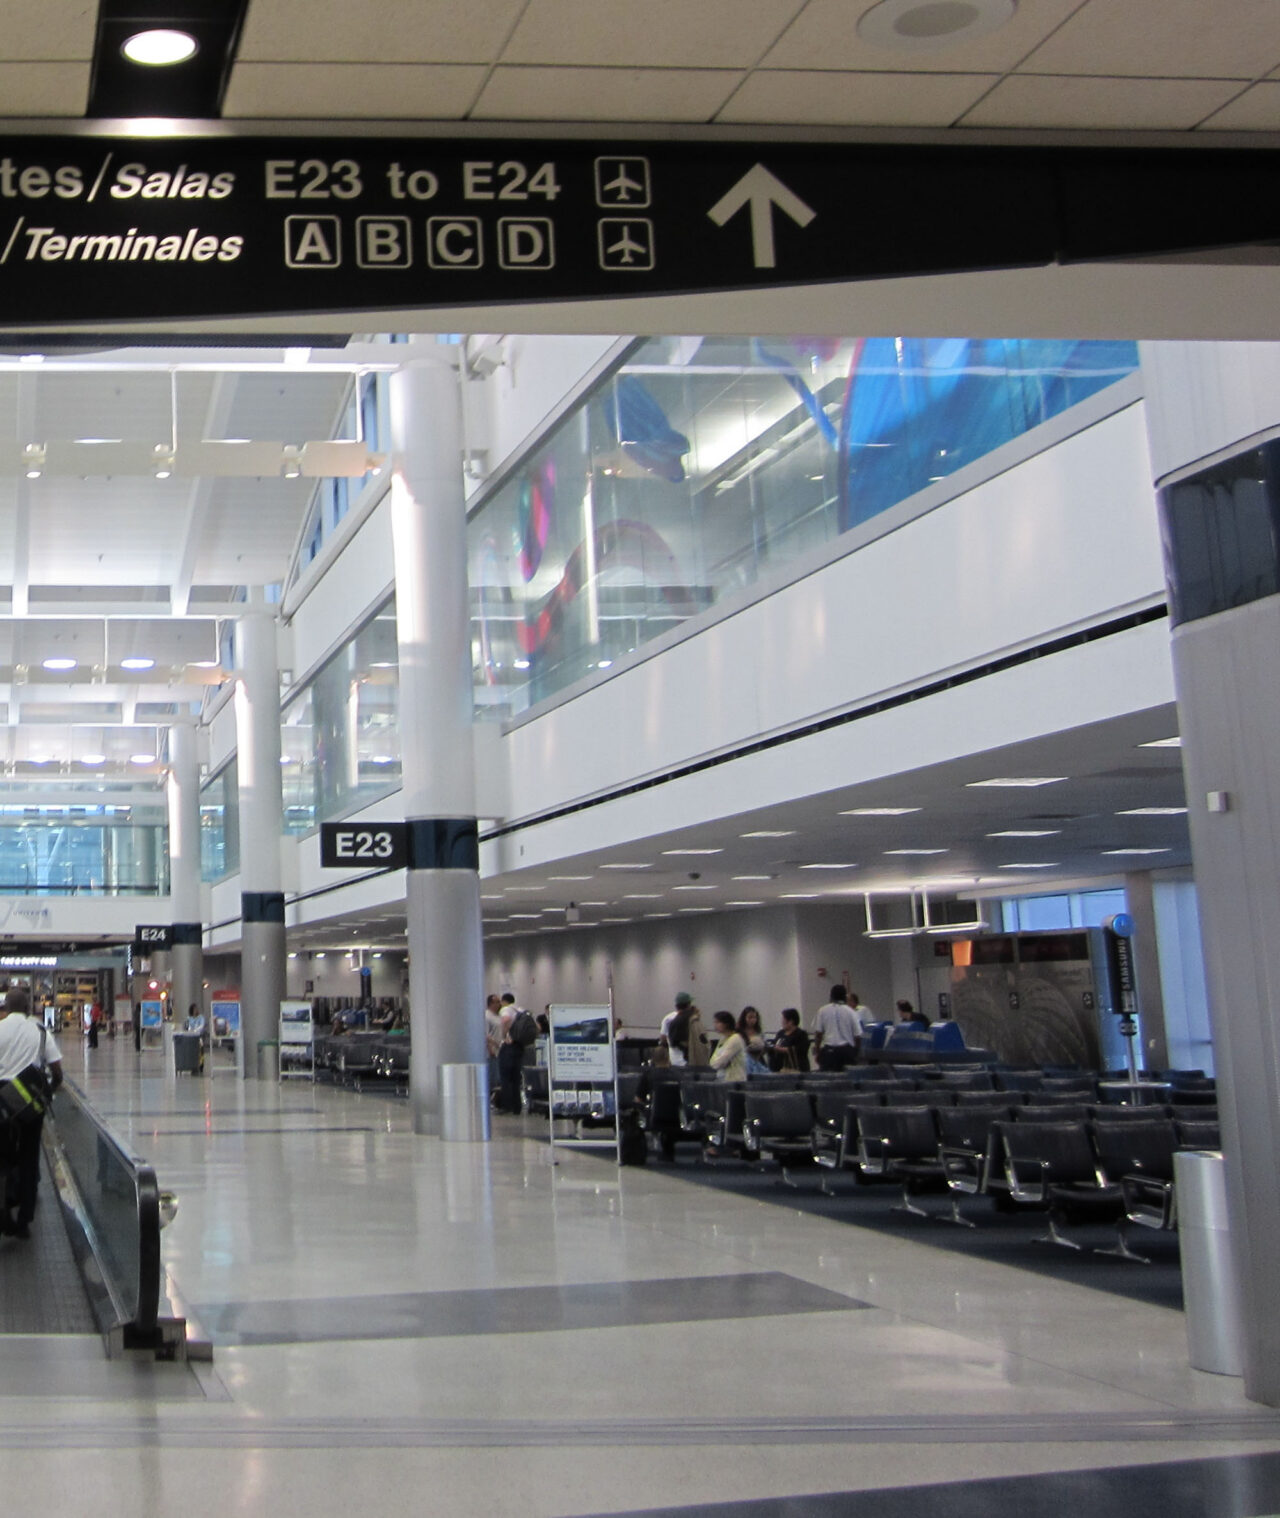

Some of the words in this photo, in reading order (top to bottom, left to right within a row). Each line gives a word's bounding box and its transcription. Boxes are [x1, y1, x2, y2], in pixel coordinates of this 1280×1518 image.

[265, 159, 363, 200] E23
[387, 162, 439, 200] to
[463, 160, 561, 200] E24
[294, 222, 332, 261] A
[366, 223, 401, 262] B
[436, 223, 473, 263] C
[508, 224, 544, 263] D
[335, 831, 393, 858] E23
[141, 927, 167, 941] E24
